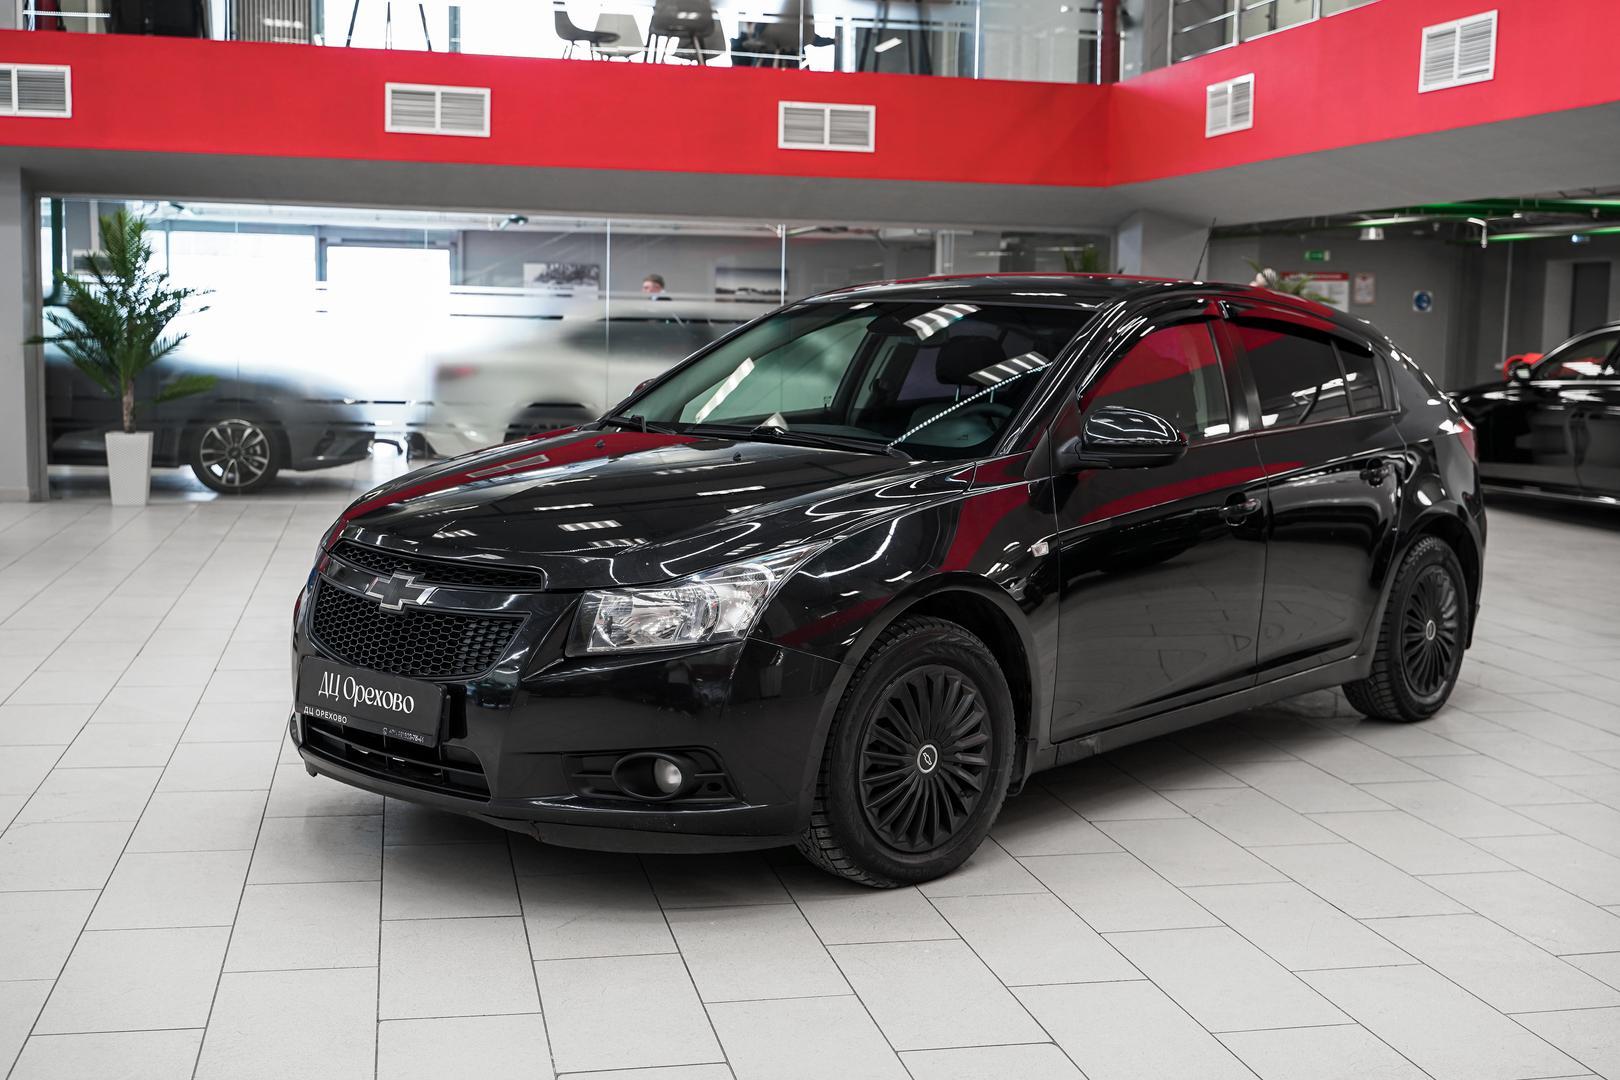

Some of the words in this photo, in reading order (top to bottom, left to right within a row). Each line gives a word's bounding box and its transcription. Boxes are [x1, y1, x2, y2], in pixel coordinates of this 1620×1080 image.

[318, 671, 341, 702] ДЦ
[343, 676, 415, 714] Орехово
[303, 706, 314, 716] ДЦ
[315, 709, 348, 724] ОРЕХОВО
